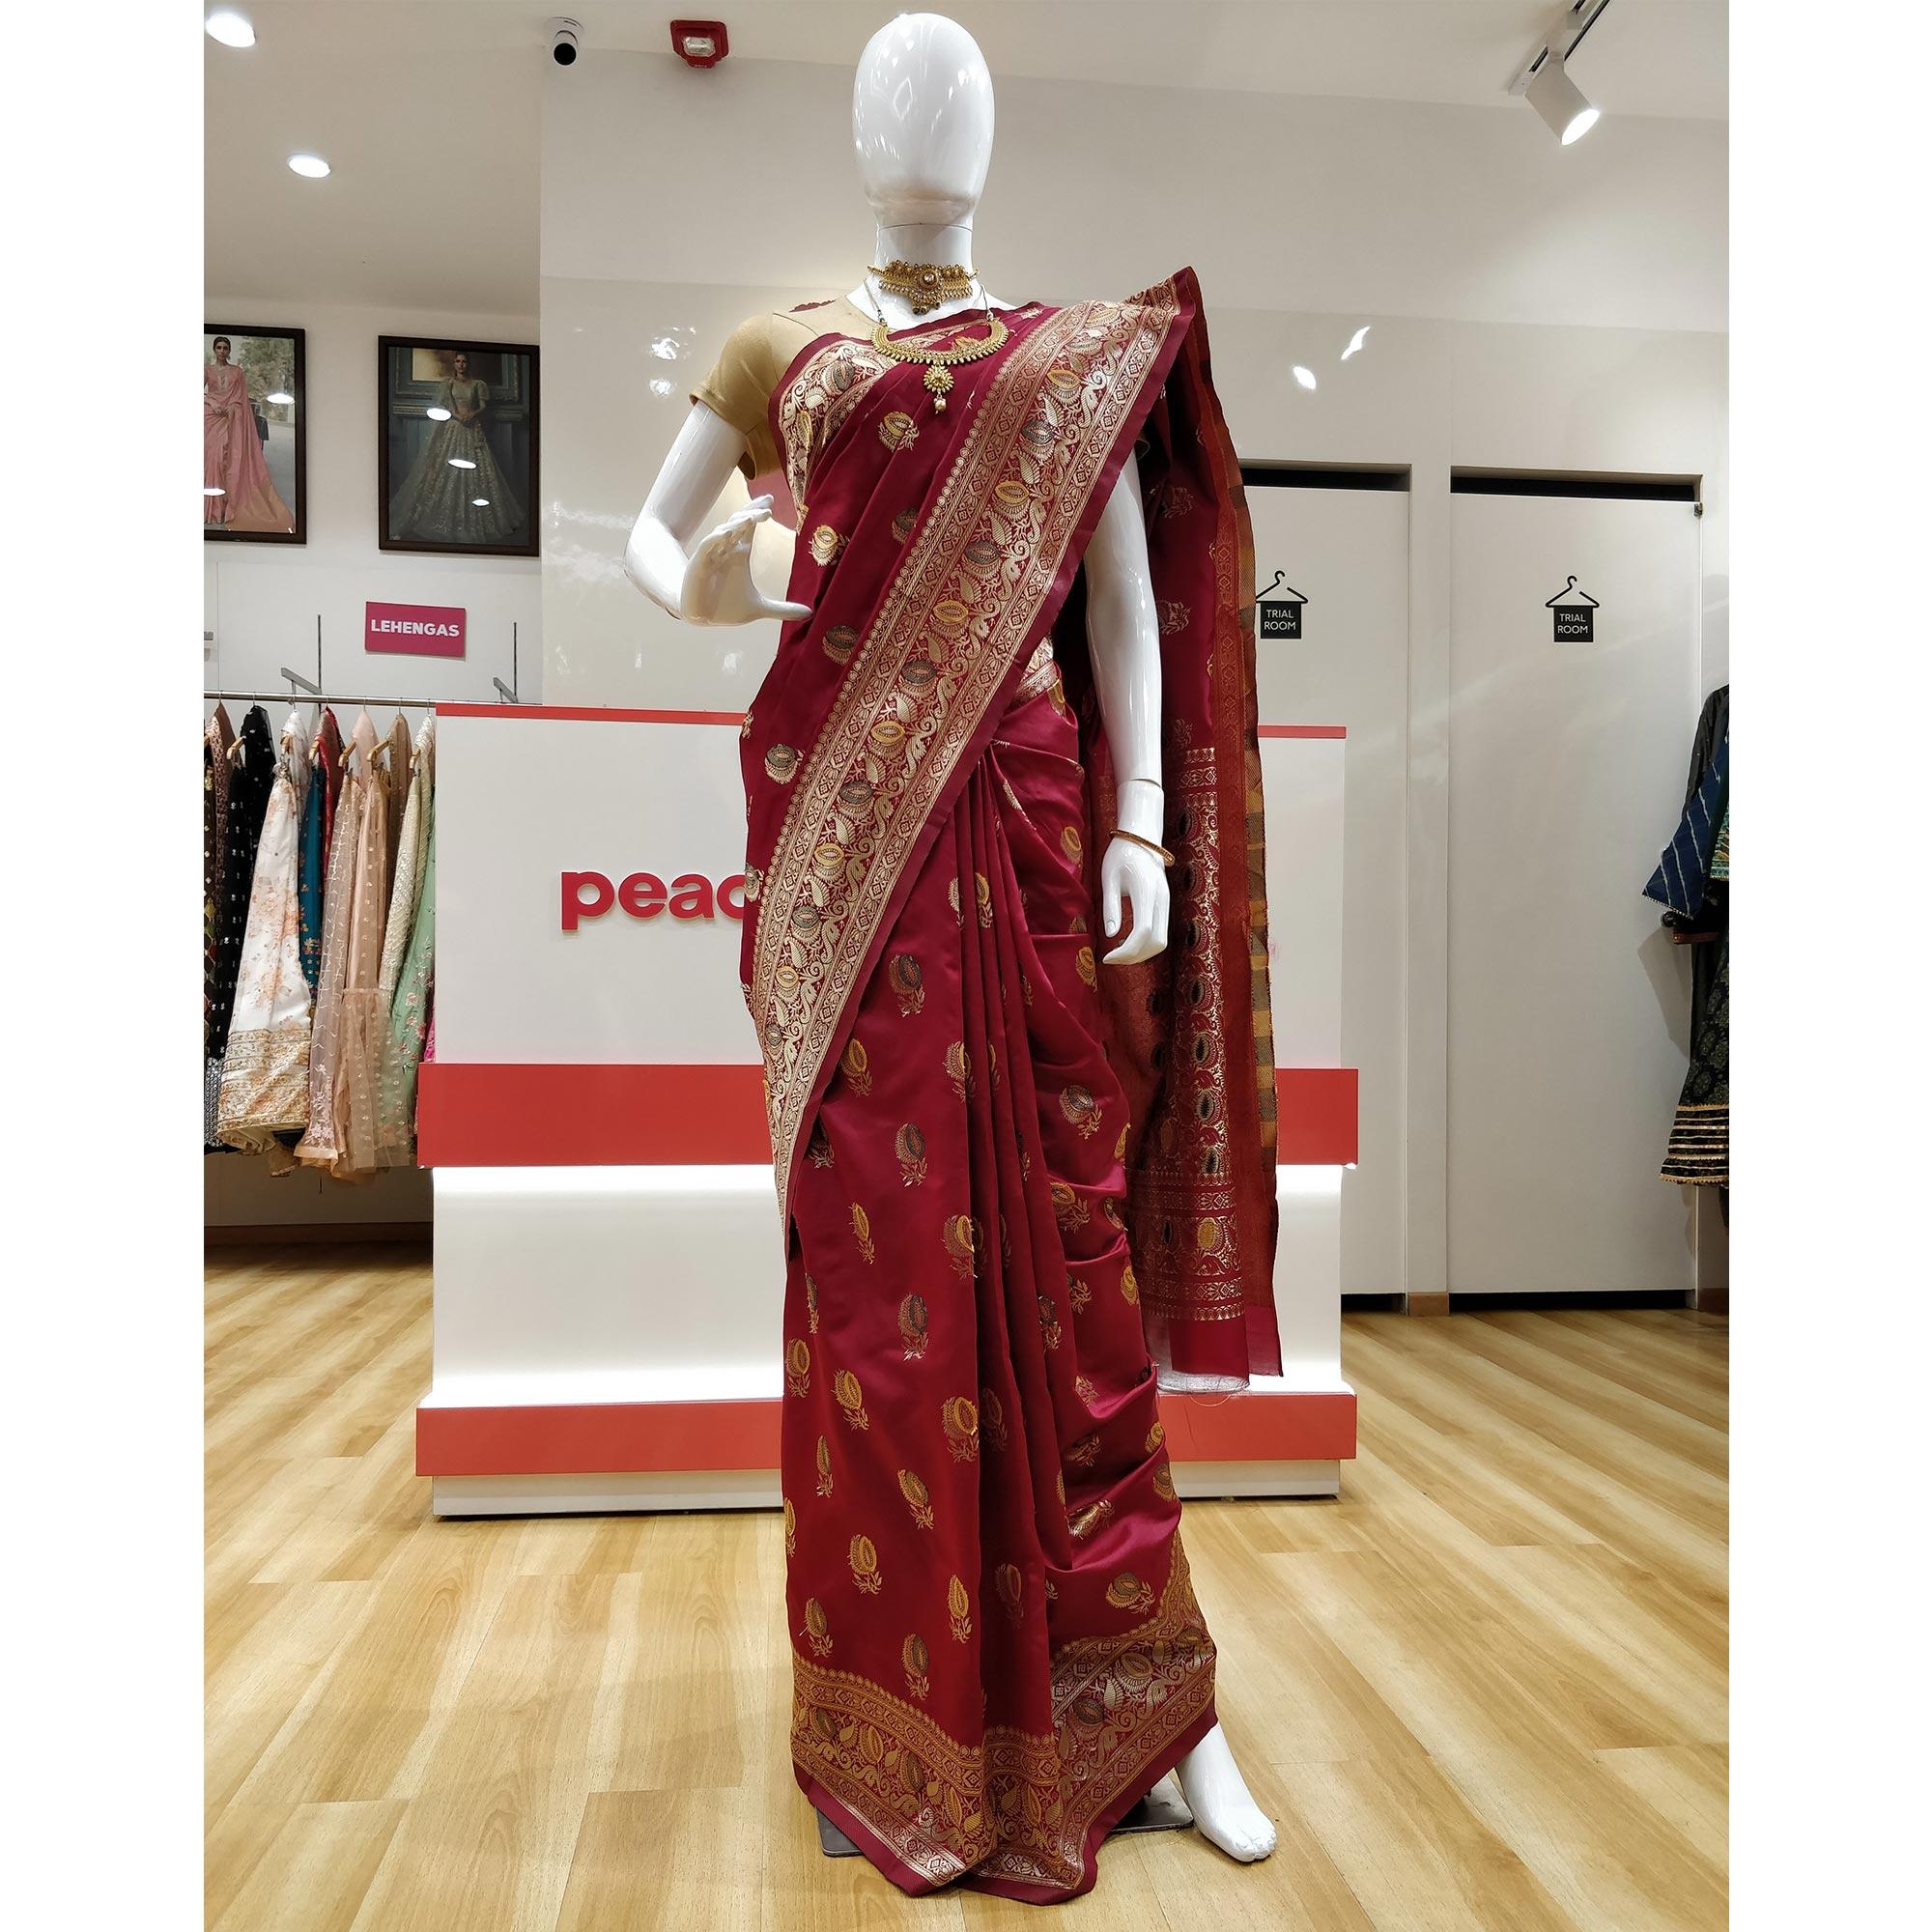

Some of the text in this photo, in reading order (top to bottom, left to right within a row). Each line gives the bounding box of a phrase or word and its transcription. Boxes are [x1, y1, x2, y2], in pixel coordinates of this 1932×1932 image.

[1265, 609, 1294, 619] TRIAL
[1559, 613, 1586, 623] TRIAL
[371, 619, 460, 638] LEHENGAS
[1264, 621, 1296, 631] ROOM
[1557, 625, 1589, 634] ROOM
